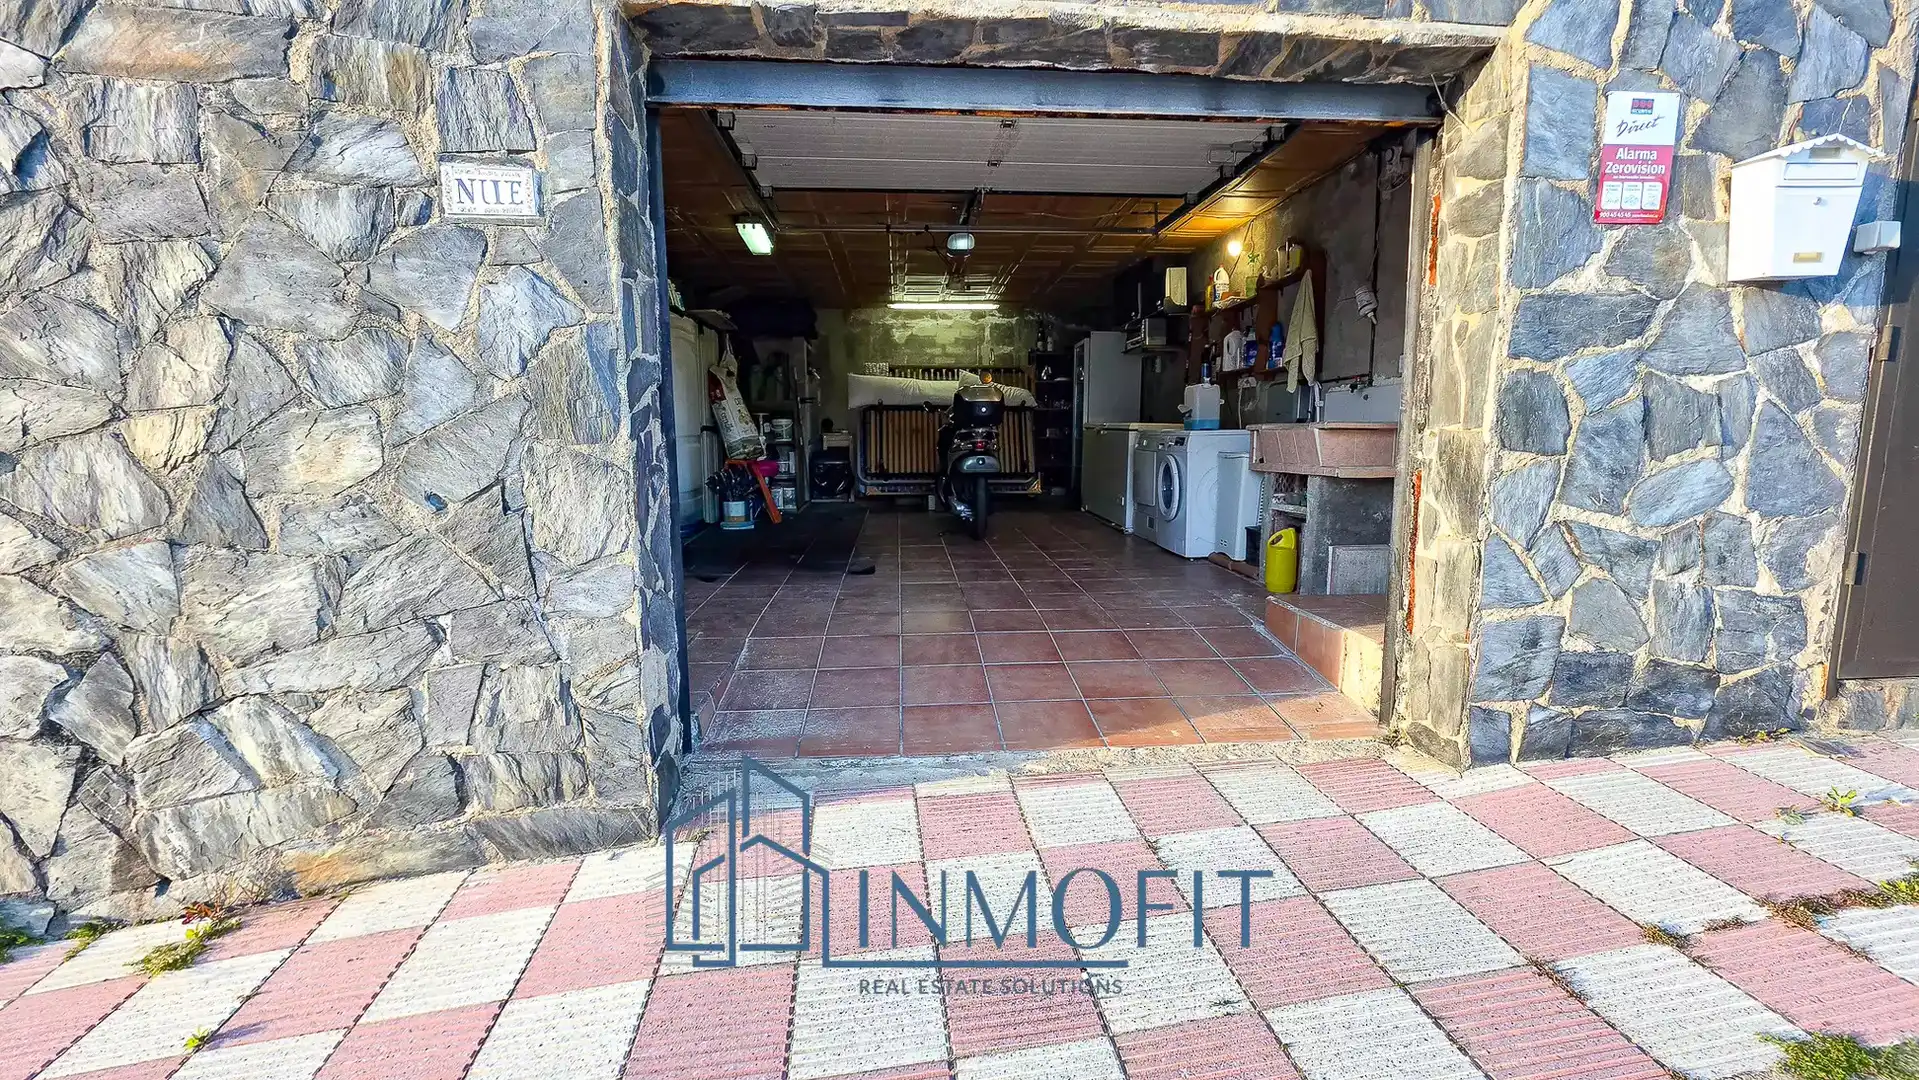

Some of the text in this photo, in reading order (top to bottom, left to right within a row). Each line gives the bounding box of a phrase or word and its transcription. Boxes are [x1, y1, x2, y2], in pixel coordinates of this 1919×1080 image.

[1616, 116, 1665, 137] Direct
[1616, 147, 1657, 160] Alarma
[1604, 161, 1666, 174] Zerovision
